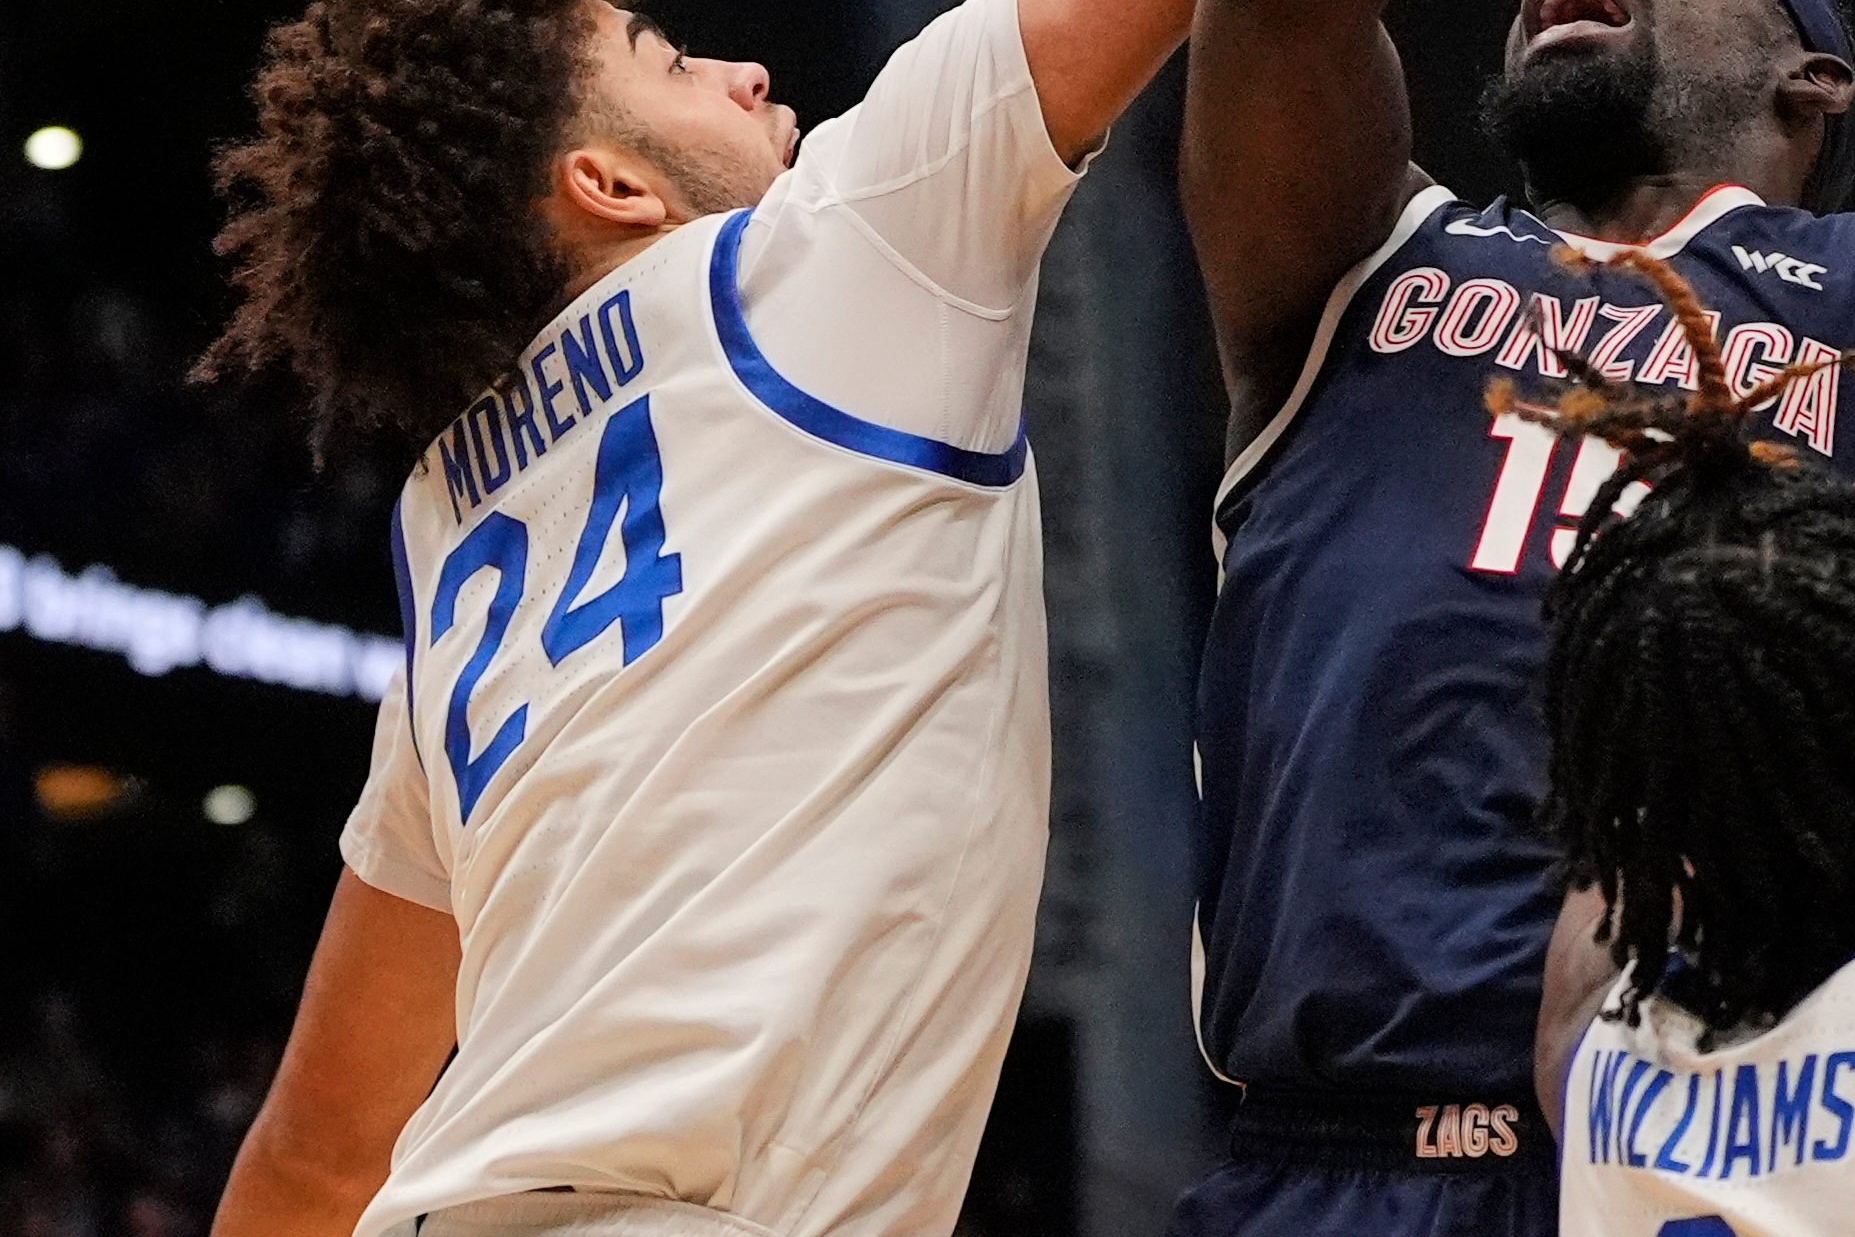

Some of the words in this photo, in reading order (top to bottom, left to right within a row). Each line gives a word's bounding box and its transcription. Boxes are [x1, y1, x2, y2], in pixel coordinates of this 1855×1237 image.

[437, 288, 645, 527] MORENO
[1368, 266, 1843, 458] GONZAGA
[430, 392, 683, 827] 24
[1415, 1102, 1519, 1158] ZAGS
